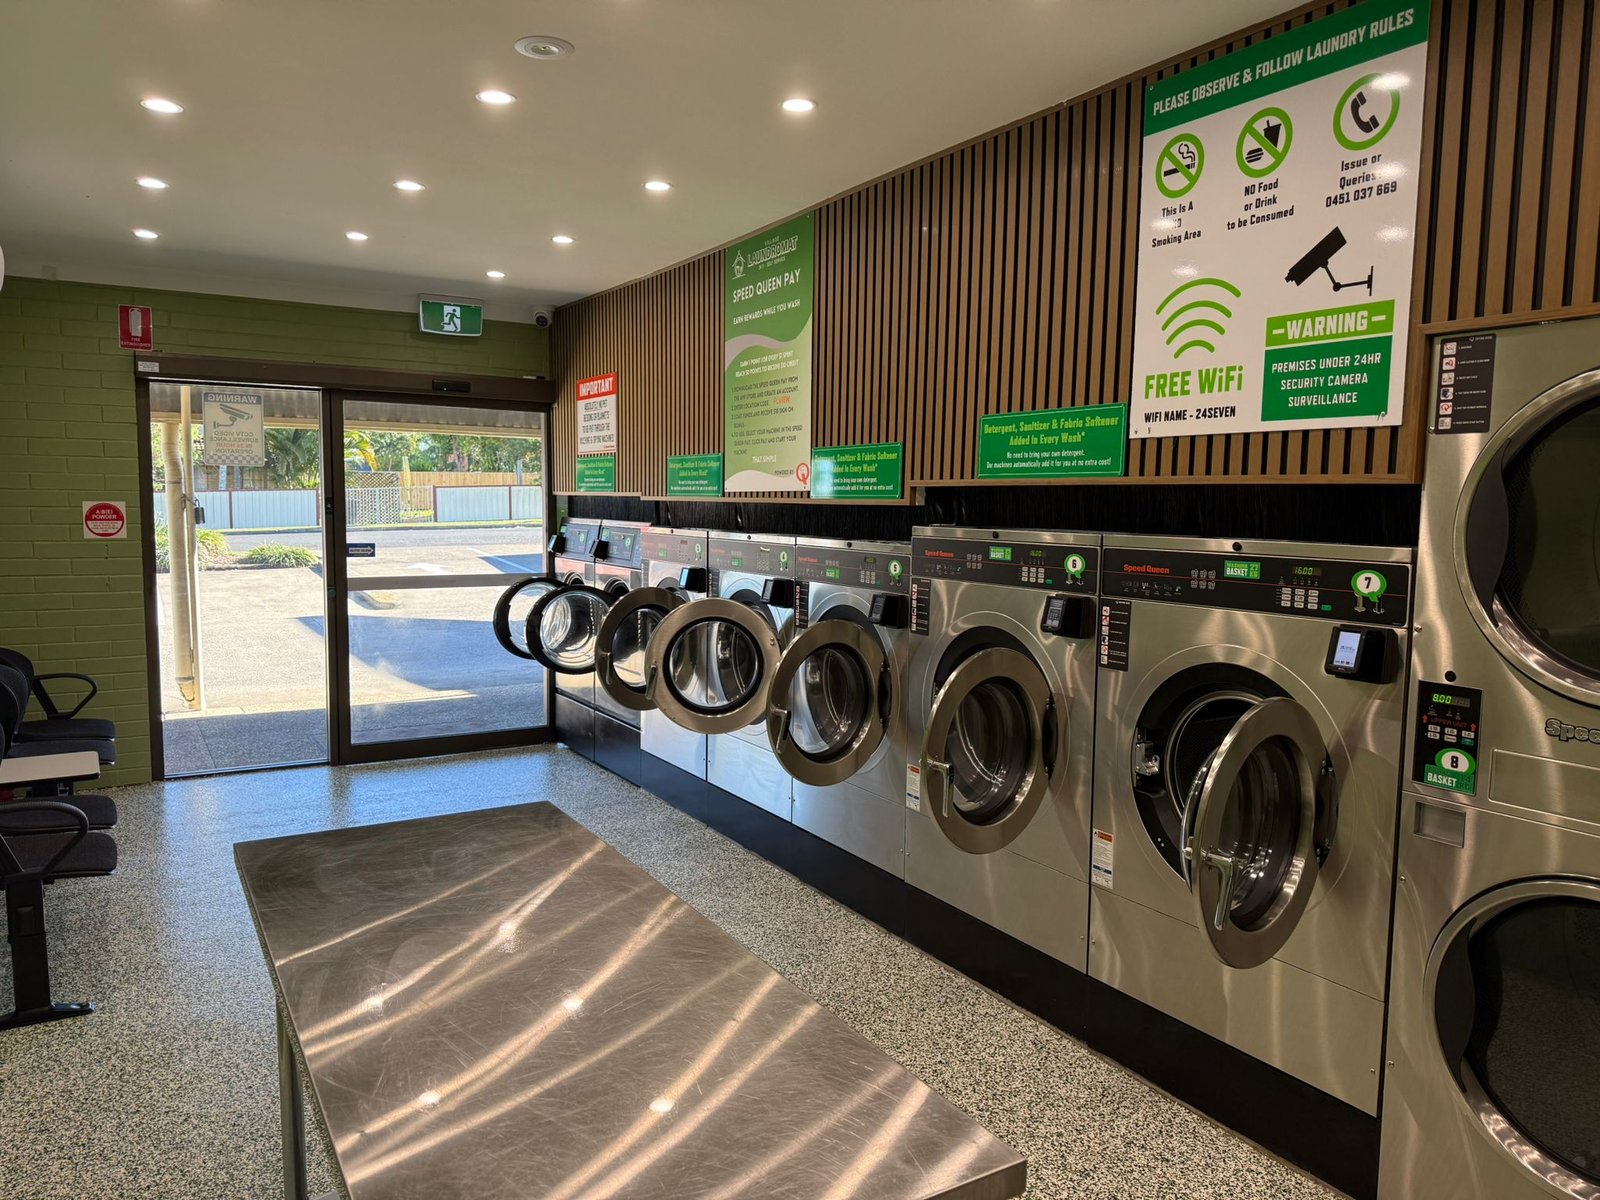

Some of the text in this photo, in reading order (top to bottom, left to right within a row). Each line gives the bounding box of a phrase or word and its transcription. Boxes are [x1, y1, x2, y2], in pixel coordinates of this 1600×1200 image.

[1153, 8, 1414, 116] PLEASE OBSERVE & FOLLOW LAUNDRY RULES
[1341, 153, 1382, 172] Issue or
[1244, 178, 1279, 196] NO Food
[1325, 181, 1397, 208] 0451 037 669
[1161, 201, 1194, 218] This Is A
[1244, 195, 1278, 212] or Drink
[1226, 206, 1294, 230] to be Consumed
[1152, 230, 1202, 248] Smoking Area
[747, 235, 799, 268] LAUNDROMAT
[733, 268, 801, 303] SPEED QUEEN PAY
[1272, 352, 1381, 373] PREMISES UNDER 24HR
[579, 377, 613, 397] IMPORTANT
[1144, 366, 1244, 399] FREE WiFi
[1280, 373, 1368, 391] SECURITY CAMERA
[1288, 392, 1357, 407] SURVEILLANCE
[1144, 411, 1162, 423] WIFI
[1164, 409, 1188, 422] NAME
[1195, 406, 1236, 420] 24SEVEN
[984, 415, 1119, 435] Detergent, Sanitizer & Fabric Softener
[1009, 435, 1030, 446] Added
[1039, 433, 1059, 445] Every
[1071, 559, 1078, 569] 6
[1123, 563, 1170, 574] Speed Queen
[1226, 567, 1248, 576] BASKET
[1364, 576, 1372, 589] 7
[1450, 755, 1459, 769] 8
[1427, 772, 1457, 787] BASKET
